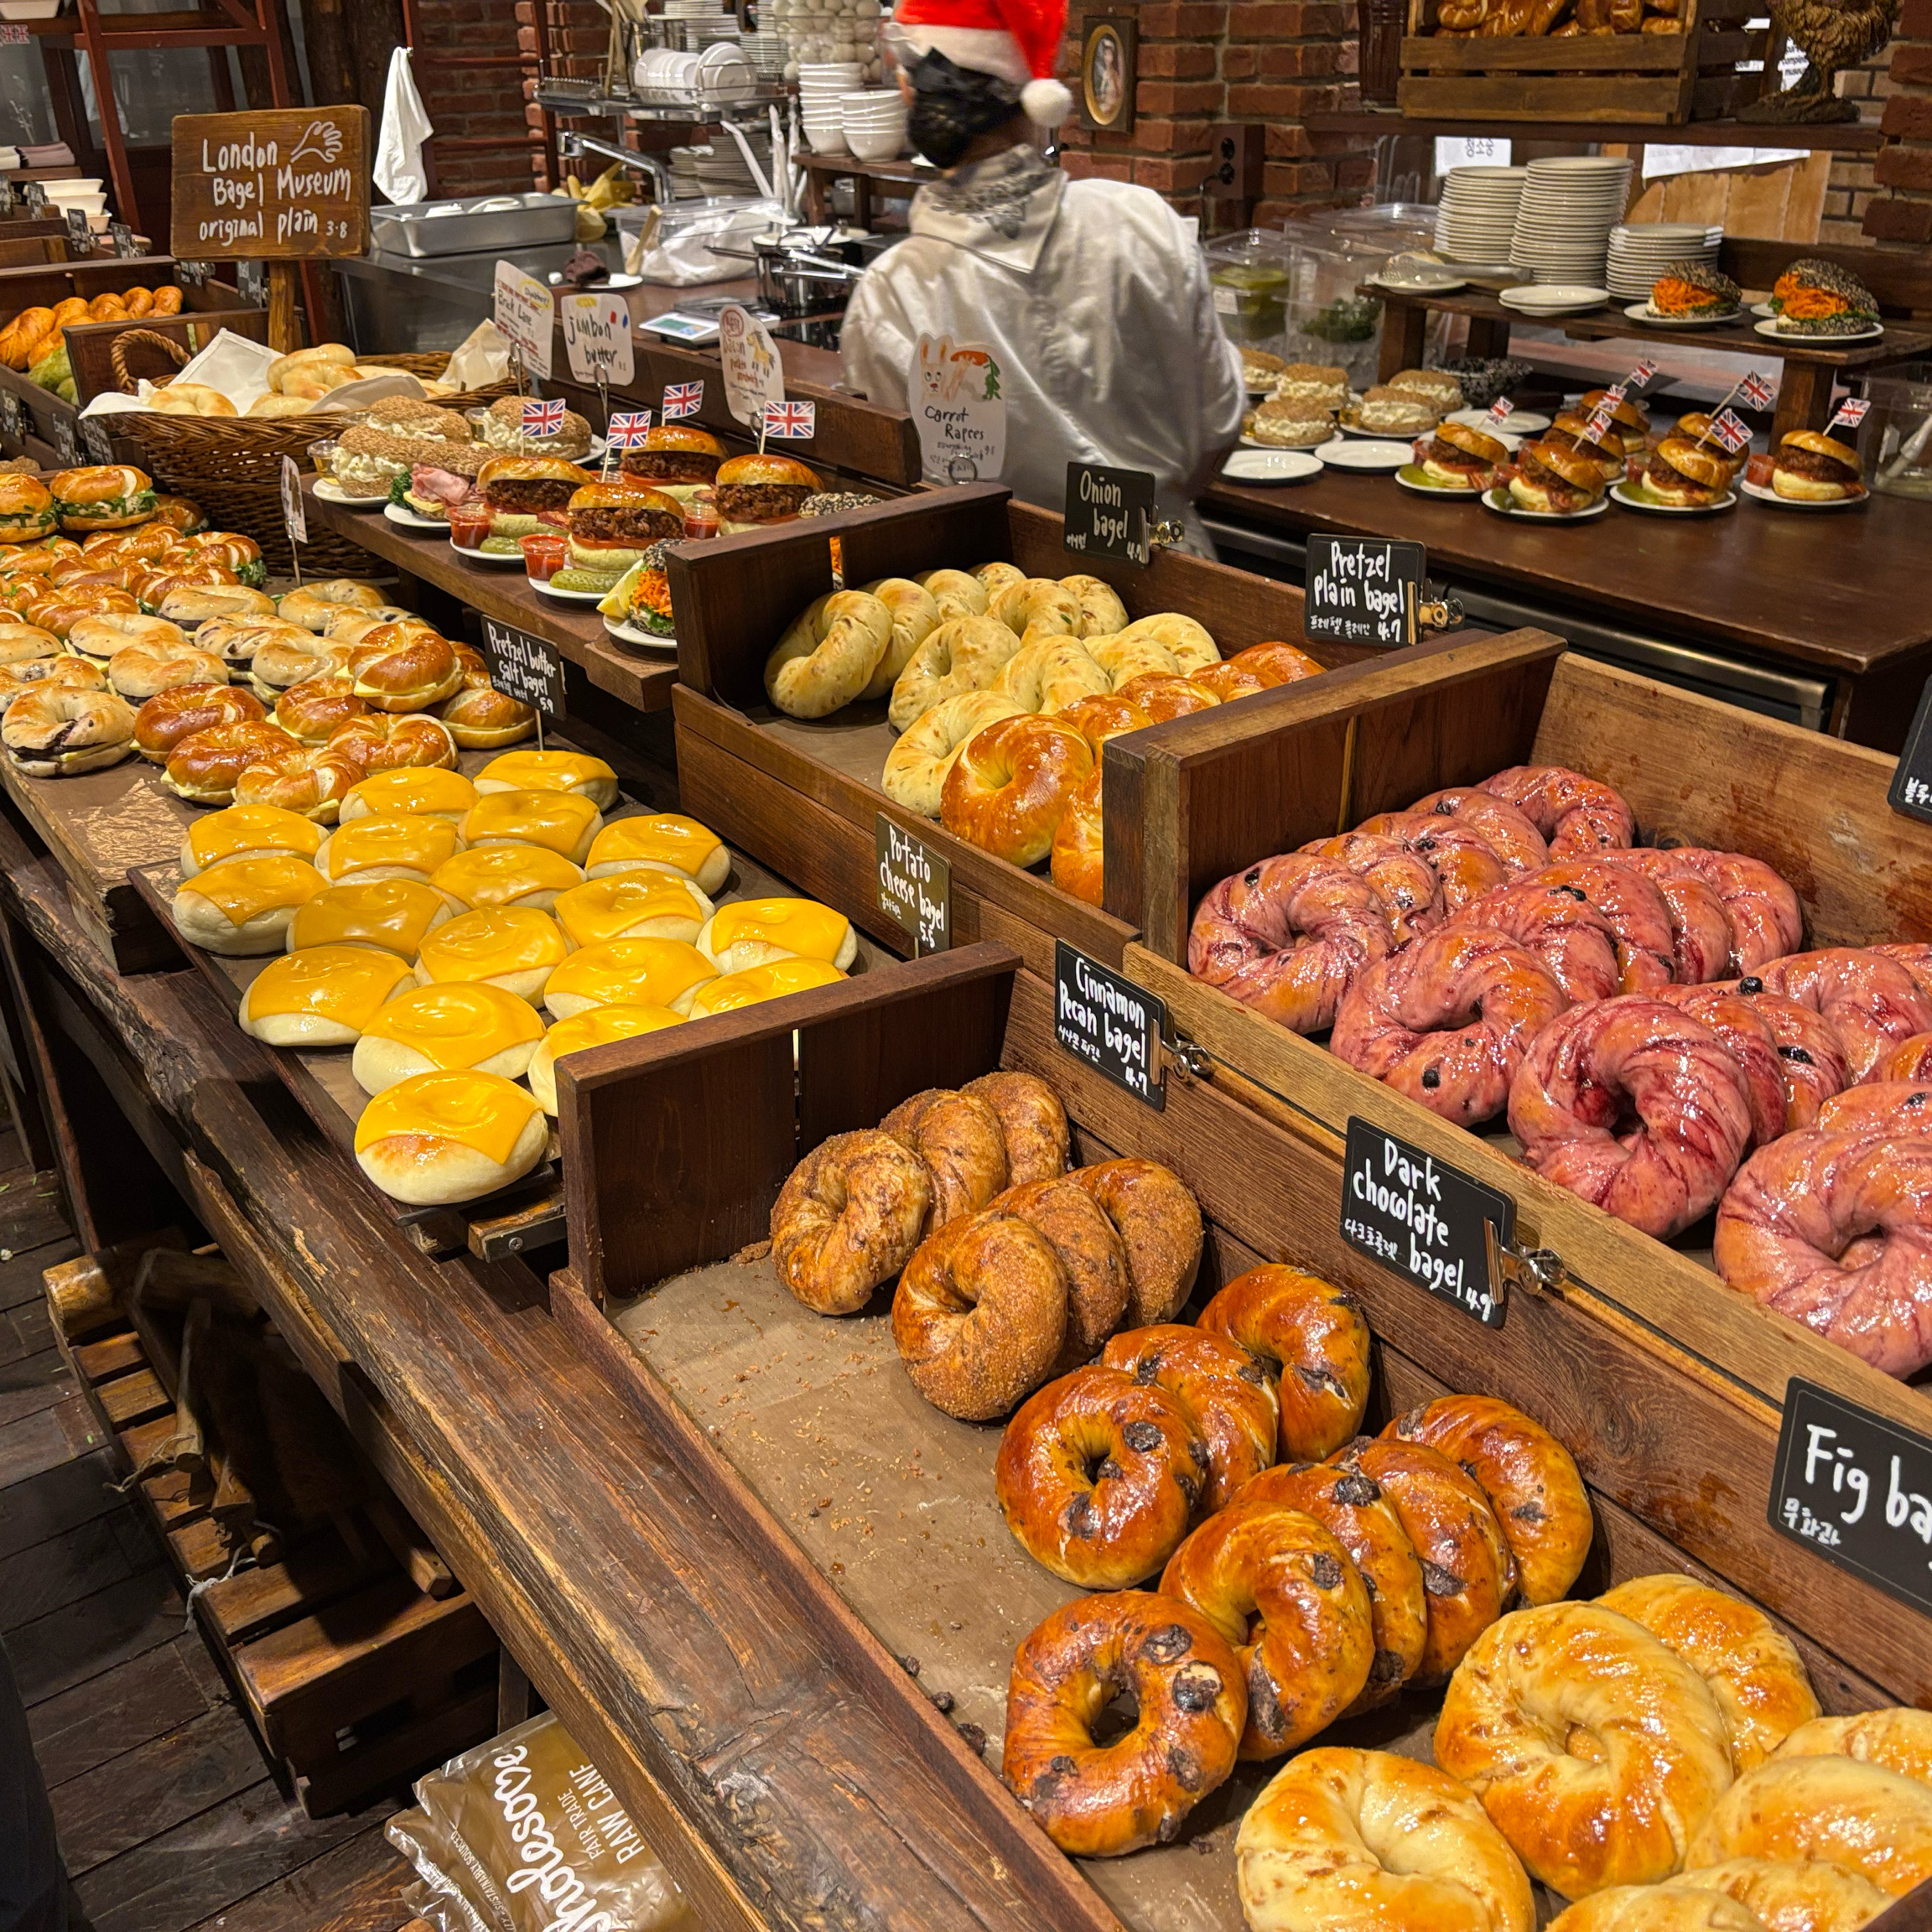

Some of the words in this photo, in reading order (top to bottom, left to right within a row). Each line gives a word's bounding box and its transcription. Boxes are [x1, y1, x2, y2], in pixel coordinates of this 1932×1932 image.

[203, 131, 278, 173] London
[213, 173, 263, 210] Bagel
[278, 164, 351, 202] Museum
[199, 210, 263, 247] original
[278, 207, 318, 245] plain
[568, 313, 612, 345] jambon
[584, 345, 618, 366] butter
[924, 405, 969, 423] Carrot
[1079, 470, 1122, 508] Onion
[1093, 507, 1129, 548] bagel
[1330, 541, 1391, 583] Pretzel
[1363, 578, 1405, 621] bagel
[487, 621, 528, 667] Pretzel
[527, 641, 557, 678] butter
[1378, 618, 1401, 642] 4.7
[519, 666, 548, 698] bagel
[539, 696, 554, 714] 5.9
[1904, 776, 1932, 805] 블루
[889, 824, 931, 883] Potato
[880, 850, 916, 908] cheese
[918, 882, 944, 932] bagel
[919, 920, 936, 948] 5.5
[1075, 957, 1145, 1031] Cinnamon
[1059, 979, 1098, 1036] Pecan
[1104, 1012, 1146, 1068] bagel
[1124, 1066, 1148, 1096] 4.7
[1384, 1137, 1441, 1202] Dark
[1353, 1158, 1450, 1247] chocolate
[1410, 1232, 1464, 1299] bagel
[1465, 1286, 1493, 1322] 4.9
[1805, 1424, 1870, 1524] Fig
[1783, 1497, 1842, 1546] 무화과
[557, 1788, 587, 1831] TRADE
[450, 1830, 475, 1866] SOURCED
[579, 1825, 605, 1860] FAIR
[596, 1810, 646, 1865] RAW
[469, 1860, 503, 1911] SUSTAINABLY
